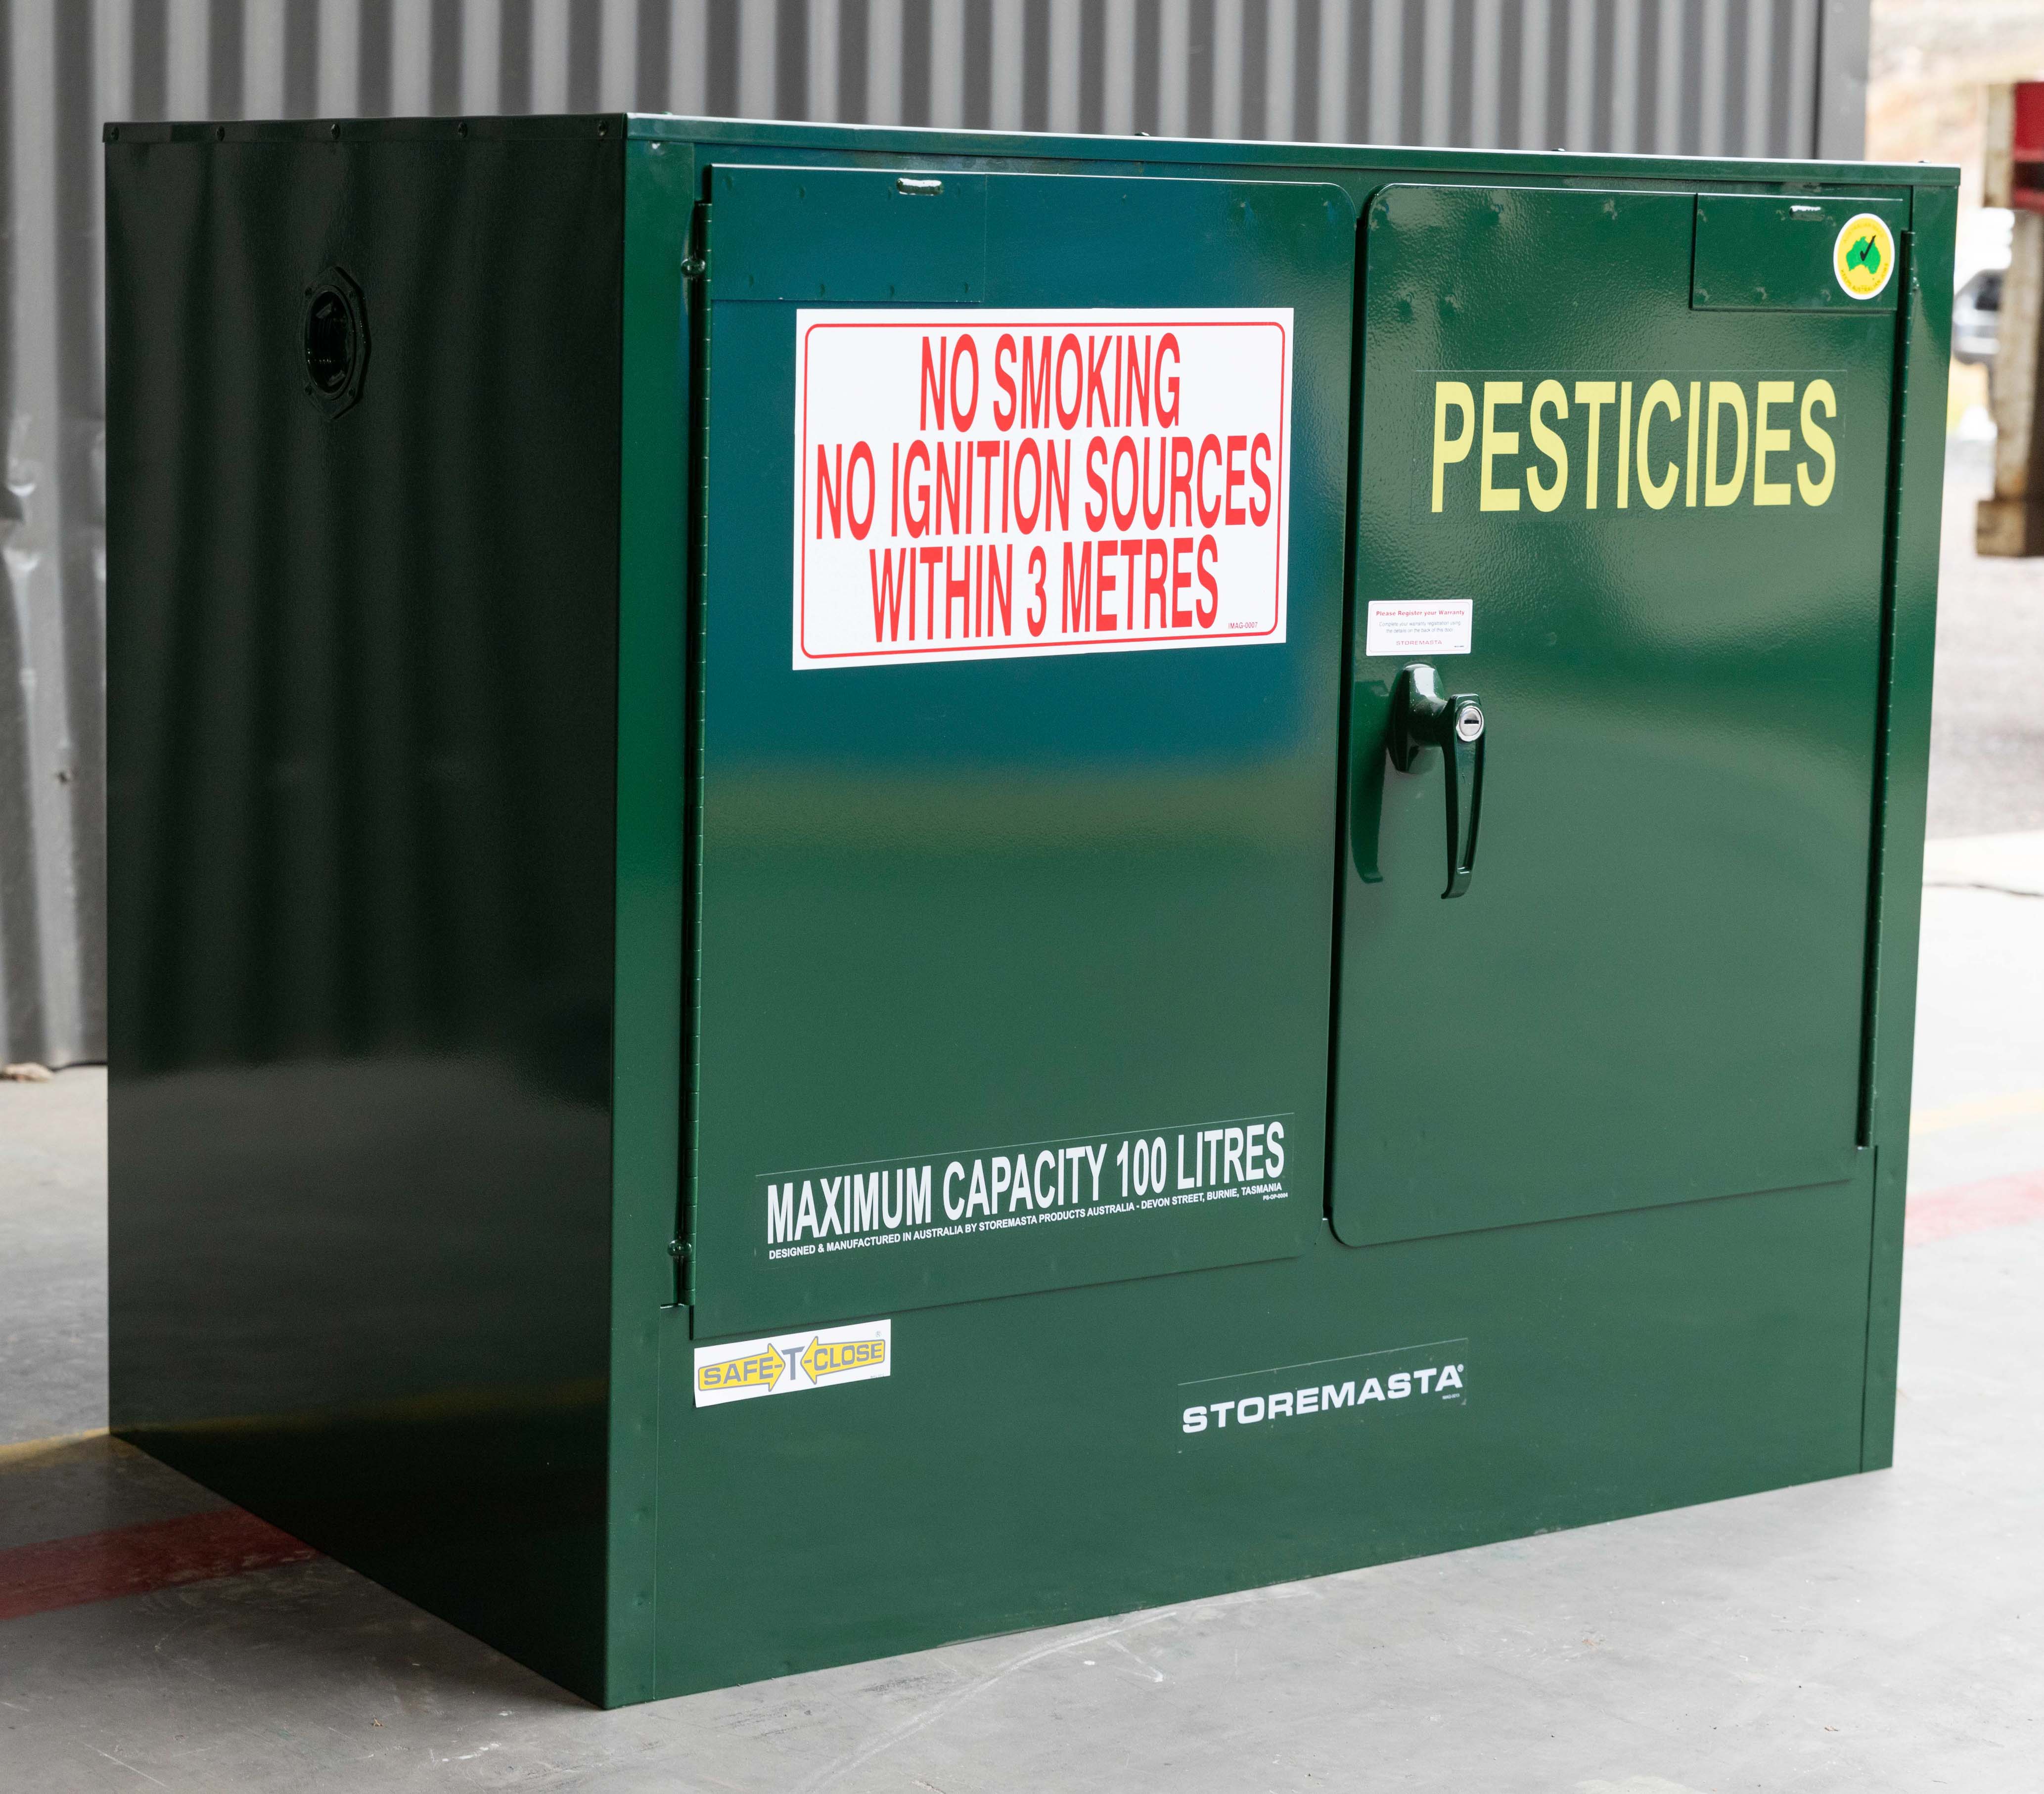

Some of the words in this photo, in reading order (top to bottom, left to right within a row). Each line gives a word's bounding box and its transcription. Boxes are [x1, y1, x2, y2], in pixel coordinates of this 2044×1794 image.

[920, 334, 979, 432] NO
[994, 333, 1180, 432] SMOKING
[817, 441, 875, 540] NO
[892, 438, 1071, 538] IGNITION
[1085, 433, 1271, 532] SOURCES
[1432, 380, 1836, 512] PESTICIDES
[869, 544, 1012, 642] WITHIN
[1027, 546, 1046, 637] 3
[1062, 535, 1218, 633] METRES
[768, 1166, 931, 1244] MAXIMUM
[944, 1144, 1107, 1220] CAPACITY
[1117, 1137, 1166, 1197] 100
[1178, 1122, 1284, 1189] LITRES
[770, 1245, 815, 1259] DESIGNED
[818, 1244, 824, 1253] &
[827, 1234, 900, 1252] MANUFACTURED
[903, 1232, 911, 1241] IN
[913, 1225, 963, 1240] AUSTRALIA
[965, 1223, 977, 1233] BY
[979, 1215, 1037, 1231] STOREMASTA
[1039, 1209, 1085, 1223] PRODUCTS
[1087, 1203, 1135, 1216] AUSTRALIA
[1141, 1198, 1170, 1209] DEVON
[1172, 1193, 1204, 1205] STREET,
[1207, 1188, 1239, 1200] BURNIE,
[1241, 1183, 1282, 1196] TASMANIA
